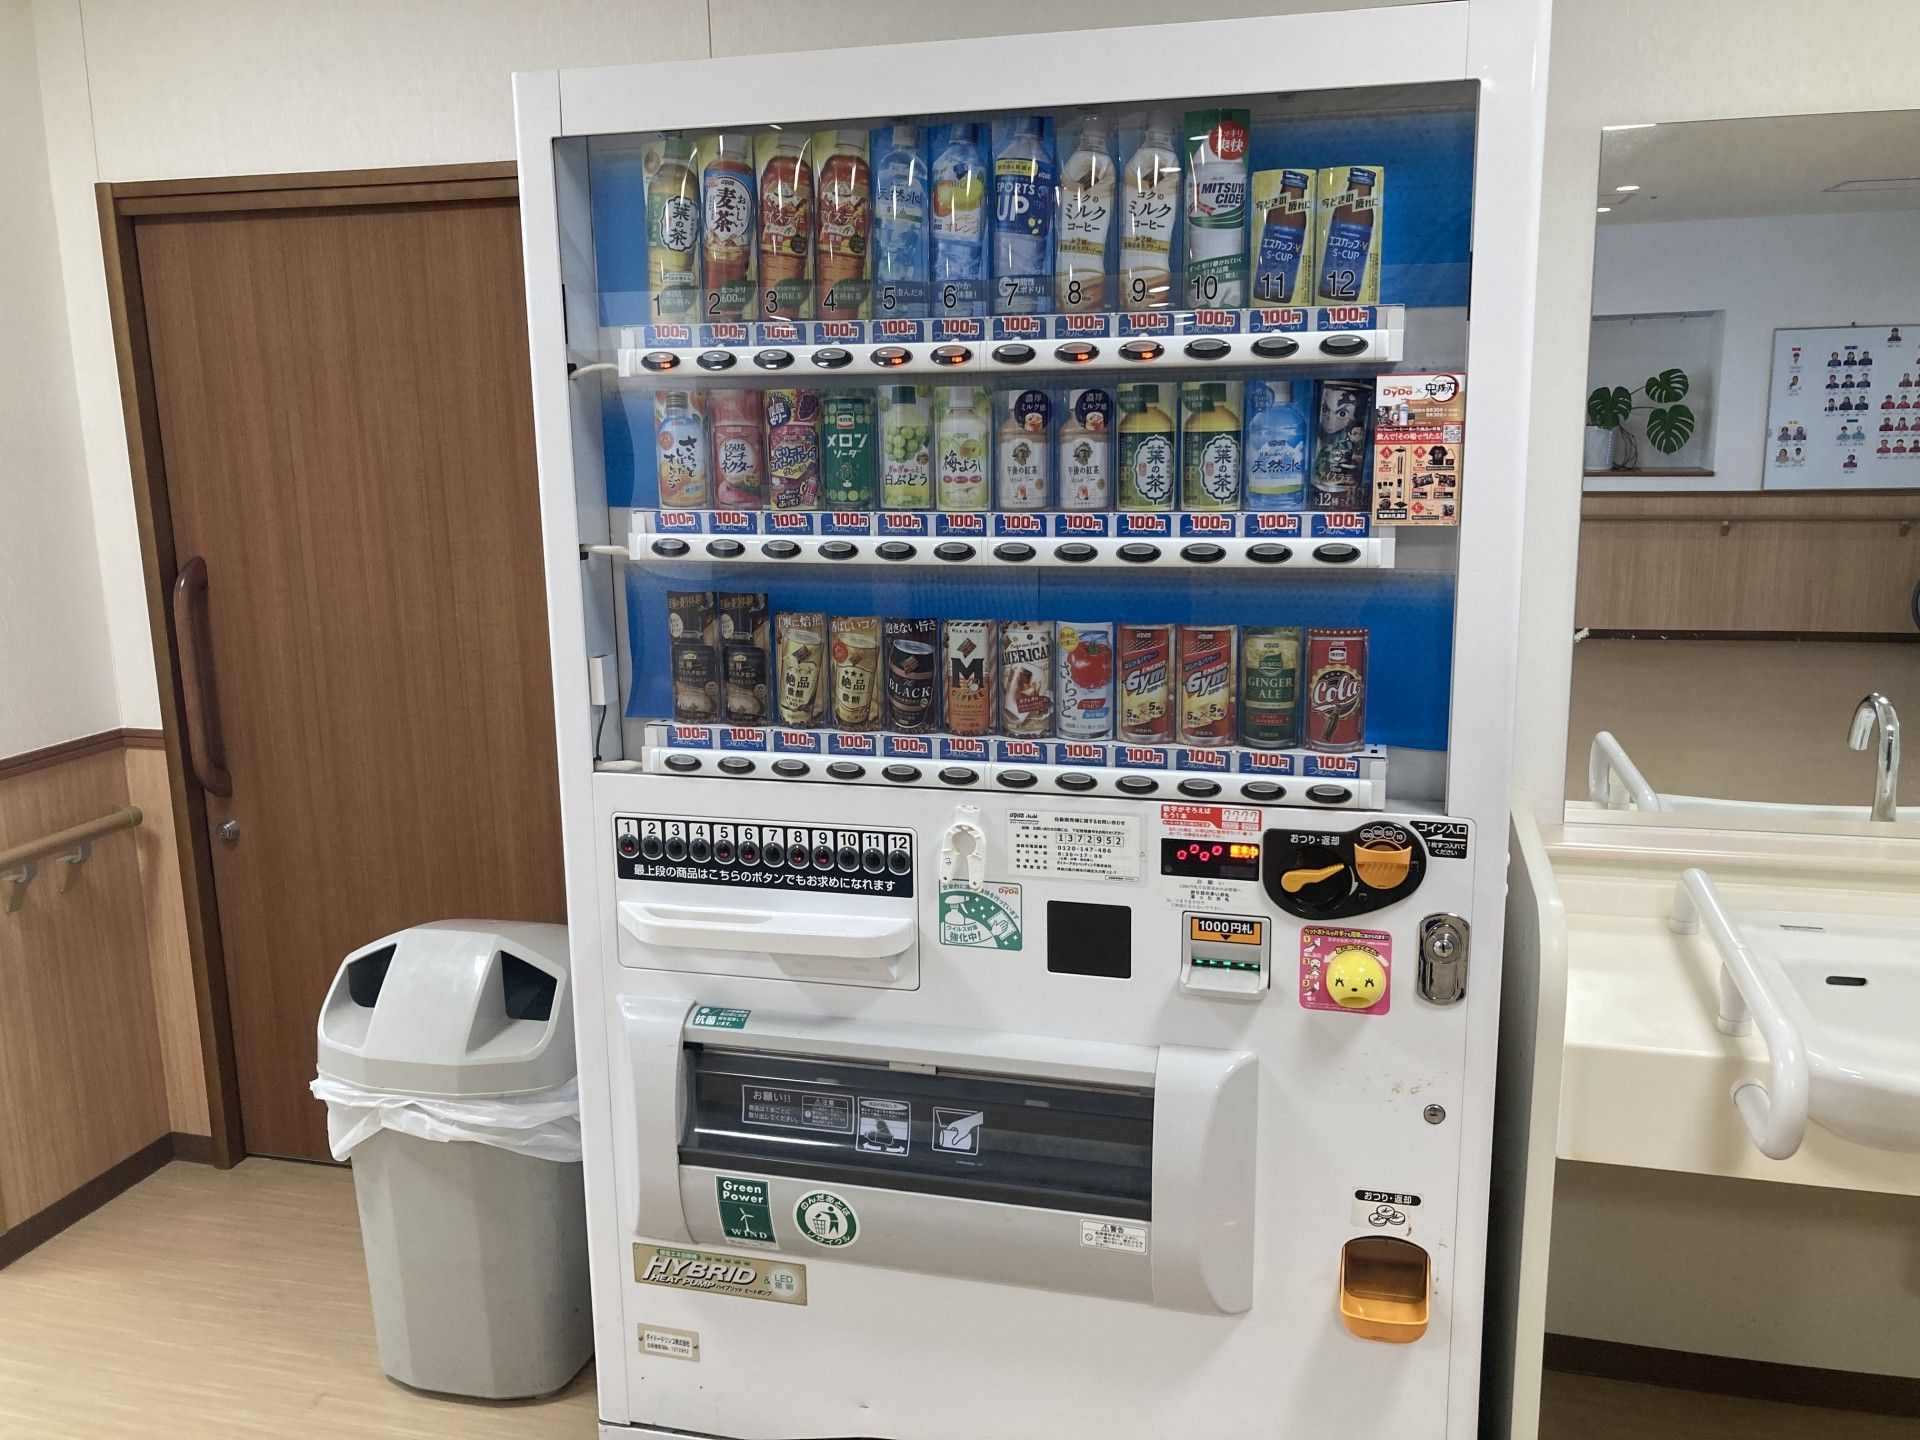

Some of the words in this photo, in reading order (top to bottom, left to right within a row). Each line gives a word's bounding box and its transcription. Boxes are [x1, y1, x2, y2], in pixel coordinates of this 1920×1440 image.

[997, 182, 1035, 196] SPORTS
[1138, 192, 1164, 201] コクの
[1256, 196, 1287, 210] 今どきの
[1322, 194, 1354, 208] 今どきの
[1355, 197, 1379, 210] 疲れに
[714, 187, 737, 233] 麦茶
[734, 194, 746, 229] おいしい
[996, 195, 1030, 222] UP
[1064, 203, 1107, 221] ミルク
[1129, 200, 1172, 218] ミルク
[1288, 200, 1312, 212] 疲れに
[669, 203, 691, 246] 葉の茶
[1067, 222, 1100, 232] コーヒー
[1266, 251, 1293, 262] S-CUP
[1332, 249, 1360, 260] S-CUP
[1132, 277, 1147, 302] 9
[1191, 275, 1218, 300] 10
[1260, 271, 1286, 299] 11
[1326, 269, 1356, 297] 12
[882, 286, 896, 310] 5
[943, 284, 957, 309] 6
[1004, 282, 1019, 306] 7
[1067, 280, 1082, 304] 8
[653, 294, 661, 316] 1
[708, 292, 721, 315] 2
[765, 290, 779, 314] 3
[823, 288, 837, 312] 4
[1129, 313, 1167, 328] 100円
[1196, 310, 1235, 326] 100円
[1261, 308, 1301, 324] 100円
[1328, 307, 1369, 323] 100円
[823, 323, 857, 337] 100円
[880, 321, 916, 334] 100円
[943, 320, 979, 335] 100円
[1003, 317, 1039, 332] 100円
[1066, 315, 1103, 331] 100円
[655, 325, 687, 338] 100円
[712, 325, 746, 338] 100円
[1383, 387, 1413, 398] DyDo
[827, 433, 869, 449] メロン
[679, 435, 698, 478] さらっと
[725, 452, 747, 462] ピーチ
[833, 449, 862, 459] ソーダ
[943, 449, 983, 473] 梅よろし
[663, 453, 680, 490] オレンジ
[721, 461, 754, 473] ネクター
[1006, 465, 1038, 475] 午後の紅茶
[1068, 465, 1100, 475] 午後の紅茶
[1145, 444, 1166, 493] 葉の茶
[1213, 443, 1232, 492] 葉の茶
[1252, 459, 1301, 474] 天然水
[885, 474, 928, 487] 白ぶどう
[661, 512, 694, 525] 100円
[715, 512, 748, 525] 100円
[773, 513, 806, 526] 100円
[834, 513, 868, 527] 100円
[886, 514, 921, 528] 100円
[947, 514, 982, 528] 100円
[1004, 515, 1039, 529] 100円
[1066, 515, 1101, 529] 100円
[1127, 515, 1165, 529] 100円
[1191, 514, 1230, 529] 100円
[1258, 514, 1296, 529] 100円
[1326, 513, 1364, 527] 100円
[951, 657, 985, 688] M
[1142, 661, 1166, 675] ENERGY
[1203, 662, 1228, 676] ENERGY
[785, 672, 810, 690] 絶品
[841, 675, 867, 691] 絶品
[889, 677, 932, 698] BLACK
[1248, 676, 1293, 687] GINGER
[1313, 672, 1361, 704] Cola
[1258, 690, 1282, 699] ALE
[675, 727, 709, 739] 100円
[730, 728, 764, 741] 100円
[782, 732, 816, 745] 100円
[837, 735, 872, 748] 100円
[892, 738, 928, 752] 100円
[949, 739, 984, 752] 100円
[1006, 743, 1040, 755] 100円
[1065, 744, 1102, 758] 100円
[1126, 747, 1163, 762] 100円
[1187, 748, 1225, 765] 100円
[1250, 752, 1289, 767] 100円
[1317, 755, 1357, 770] 100円
[624, 822, 631, 833] 1
[647, 823, 656, 834] 2
[671, 824, 680, 836] 3
[695, 825, 704, 837] 4
[720, 827, 728, 839] 5
[744, 828, 753, 840] 6
[768, 829, 777, 842] 7
[794, 831, 803, 843] 8
[819, 832, 828, 845] 9
[840, 834, 856, 846] 10
[866, 835, 880, 847] 11
[891, 836, 907, 849] 12
[1418, 823, 1467, 835] コイン入口
[1290, 834, 1340, 846] おつり・返却
[1434, 848, 1458, 856] ください
[634, 863, 896, 892] 最上段の商品はこちらのボタンでもお求めになれます
[1199, 920, 1253, 934] 1000円札
[950, 932, 982, 943] 強化中!
[694, 1015, 717, 1026] 抗菌
[753, 1089, 792, 1104] お願い!!
[722, 1181, 762, 1194] Green
[723, 1191, 764, 1204] Power
[800, 1192, 851, 1217] のんだあとは
[1363, 1190, 1413, 1205] おつり・返却
[730, 1227, 768, 1240] WIND
[806, 1229, 851, 1246] リサイクル
[642, 1256, 757, 1285] HYBRID
[652, 1273, 682, 1285] HEAT
[682, 1277, 716, 1289] PUMP
[763, 1275, 771, 1285] &
[774, 1274, 793, 1284] LED
[775, 1282, 794, 1292] 照明
